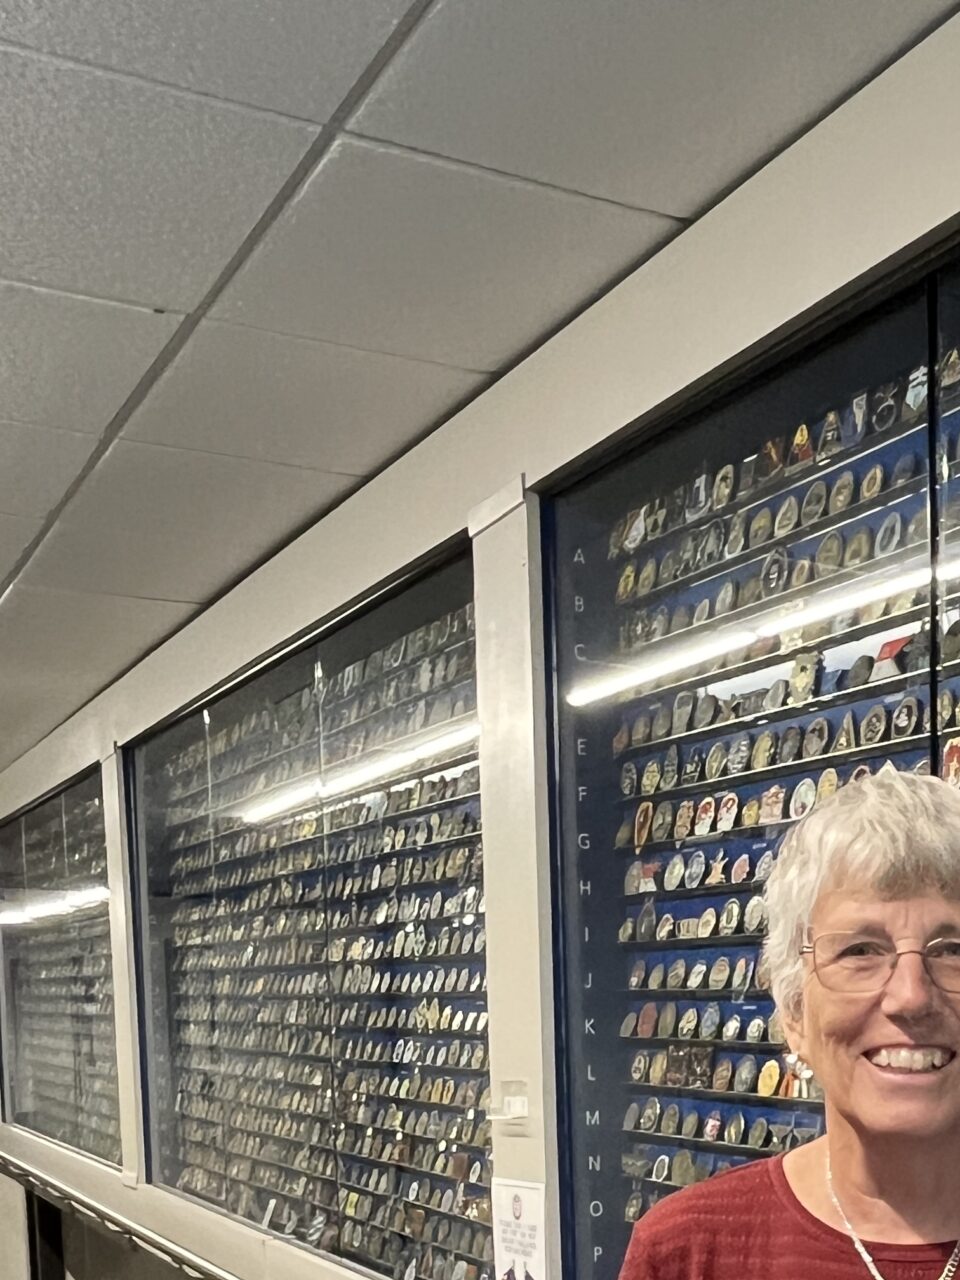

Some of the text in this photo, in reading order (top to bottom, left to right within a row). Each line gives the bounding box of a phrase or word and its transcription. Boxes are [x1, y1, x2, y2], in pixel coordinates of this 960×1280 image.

[573, 548, 585, 564] A
[575, 595, 584, 612] B
[574, 643, 586, 660] C
[577, 738, 587, 755] E
[578, 786, 588, 801] F
[577, 833, 590, 849] G
[580, 880, 591, 895] H
[584, 926, 589, 942] I
[584, 973, 593, 988] J
[585, 1018, 595, 1034] K
[587, 1065, 596, 1081] L
[585, 1110, 600, 1126] M
[588, 1155, 600, 1171] N
[589, 1201, 604, 1217] O
[594, 1246, 603, 1262] P
